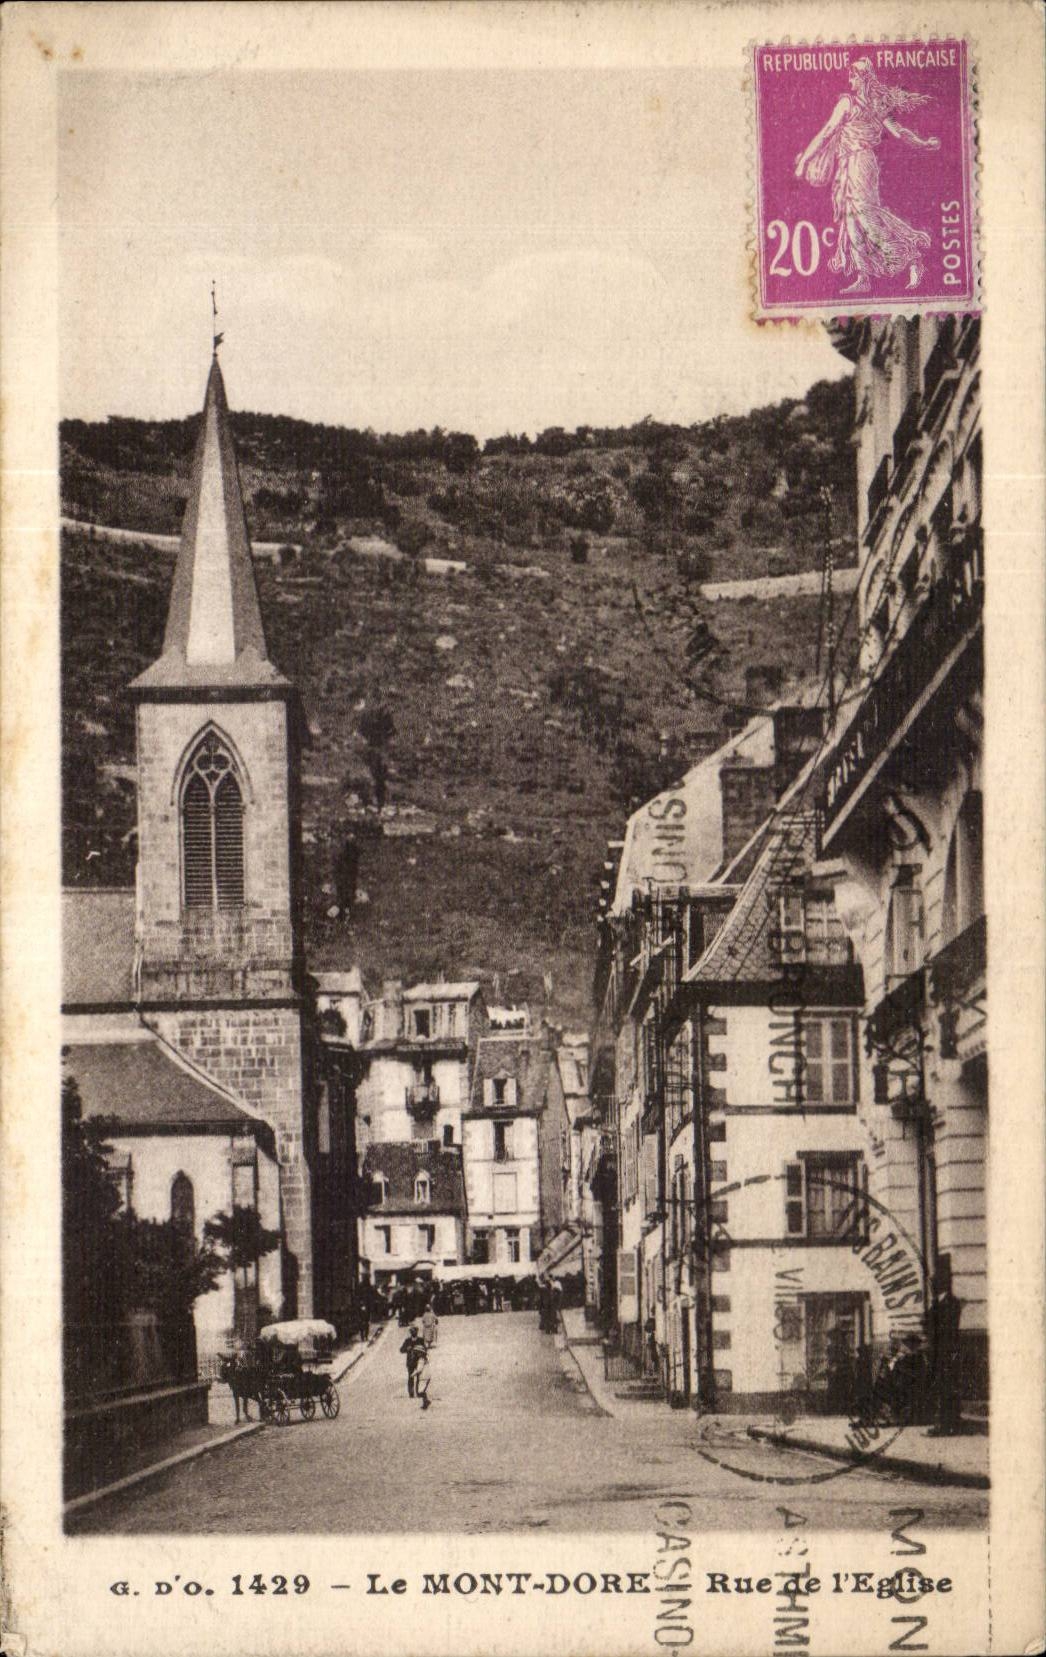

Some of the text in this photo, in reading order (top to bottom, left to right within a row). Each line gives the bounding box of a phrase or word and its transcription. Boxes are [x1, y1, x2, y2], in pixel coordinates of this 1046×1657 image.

[763, 48, 957, 72] REPUBLIQUE FRANÇAISE
[941, 200, 962, 287] POSTES
[861, 1233, 923, 1310] BAINS
